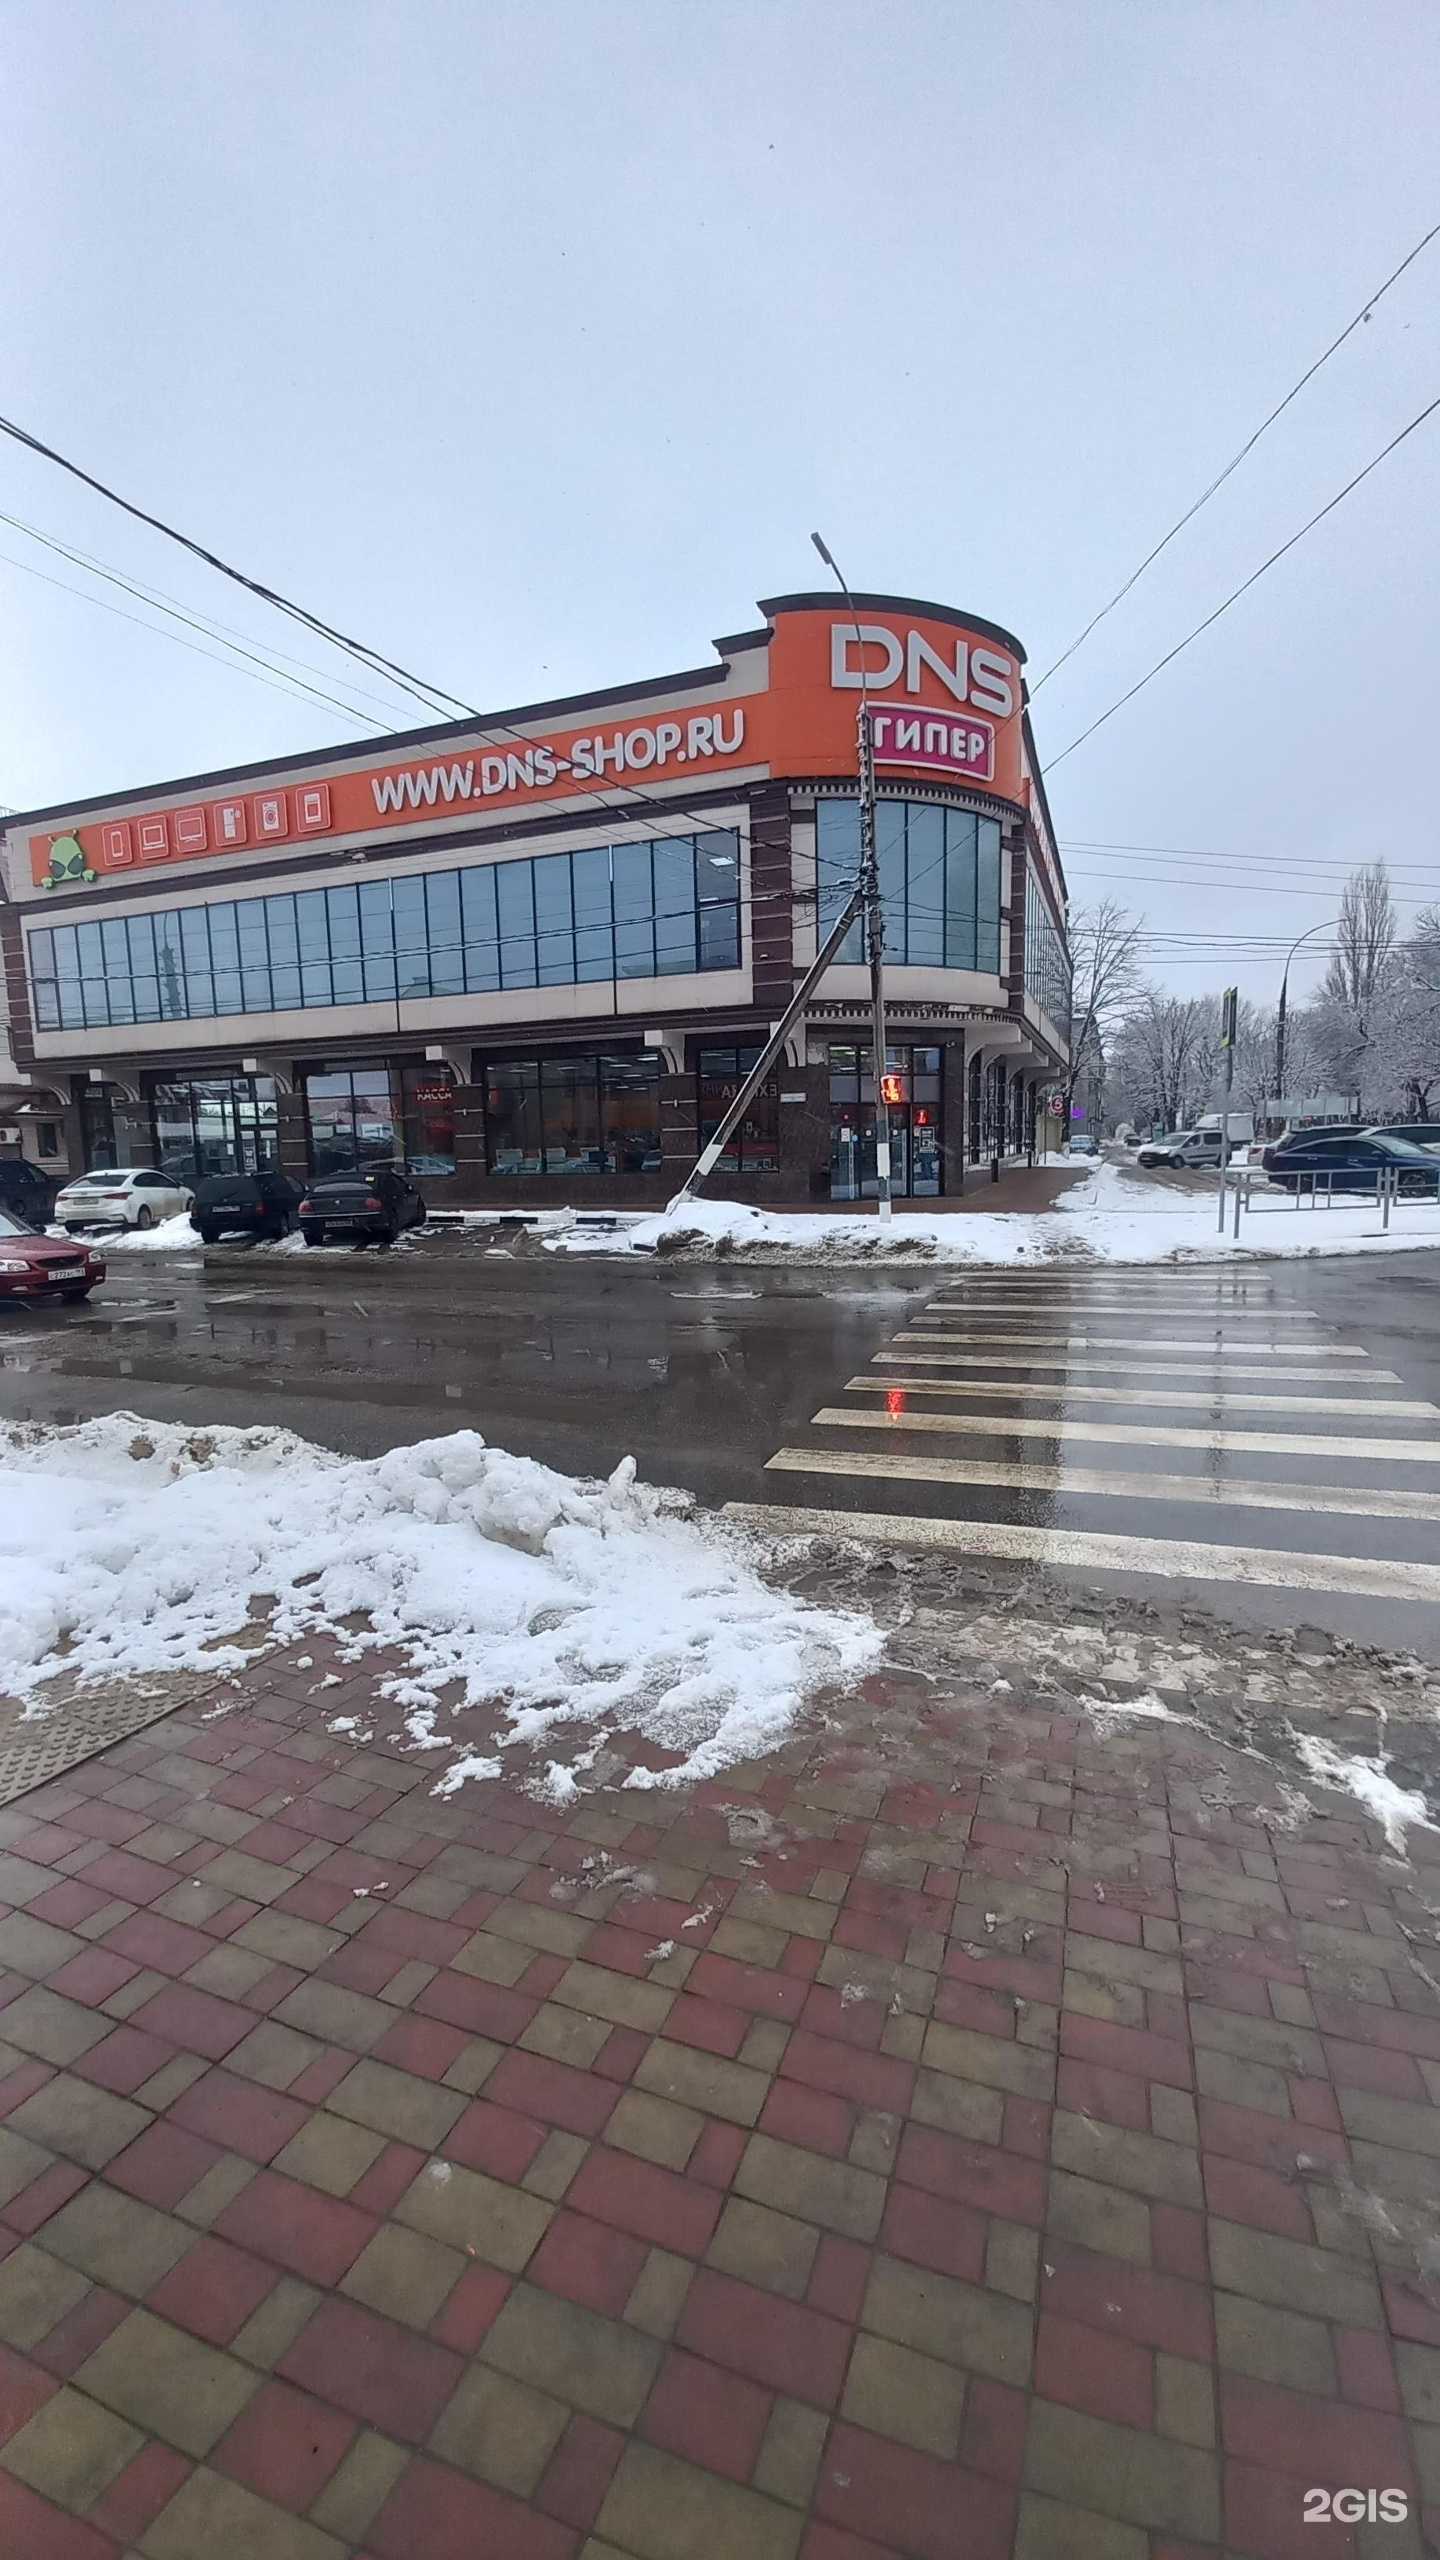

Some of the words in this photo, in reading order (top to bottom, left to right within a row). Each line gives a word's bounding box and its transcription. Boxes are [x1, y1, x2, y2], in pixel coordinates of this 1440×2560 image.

[831, 624, 1013, 718] DNS
[371, 709, 744, 814] WWW.DNS-SHOP.RU
[874, 717, 985, 762] ГИПЕР
